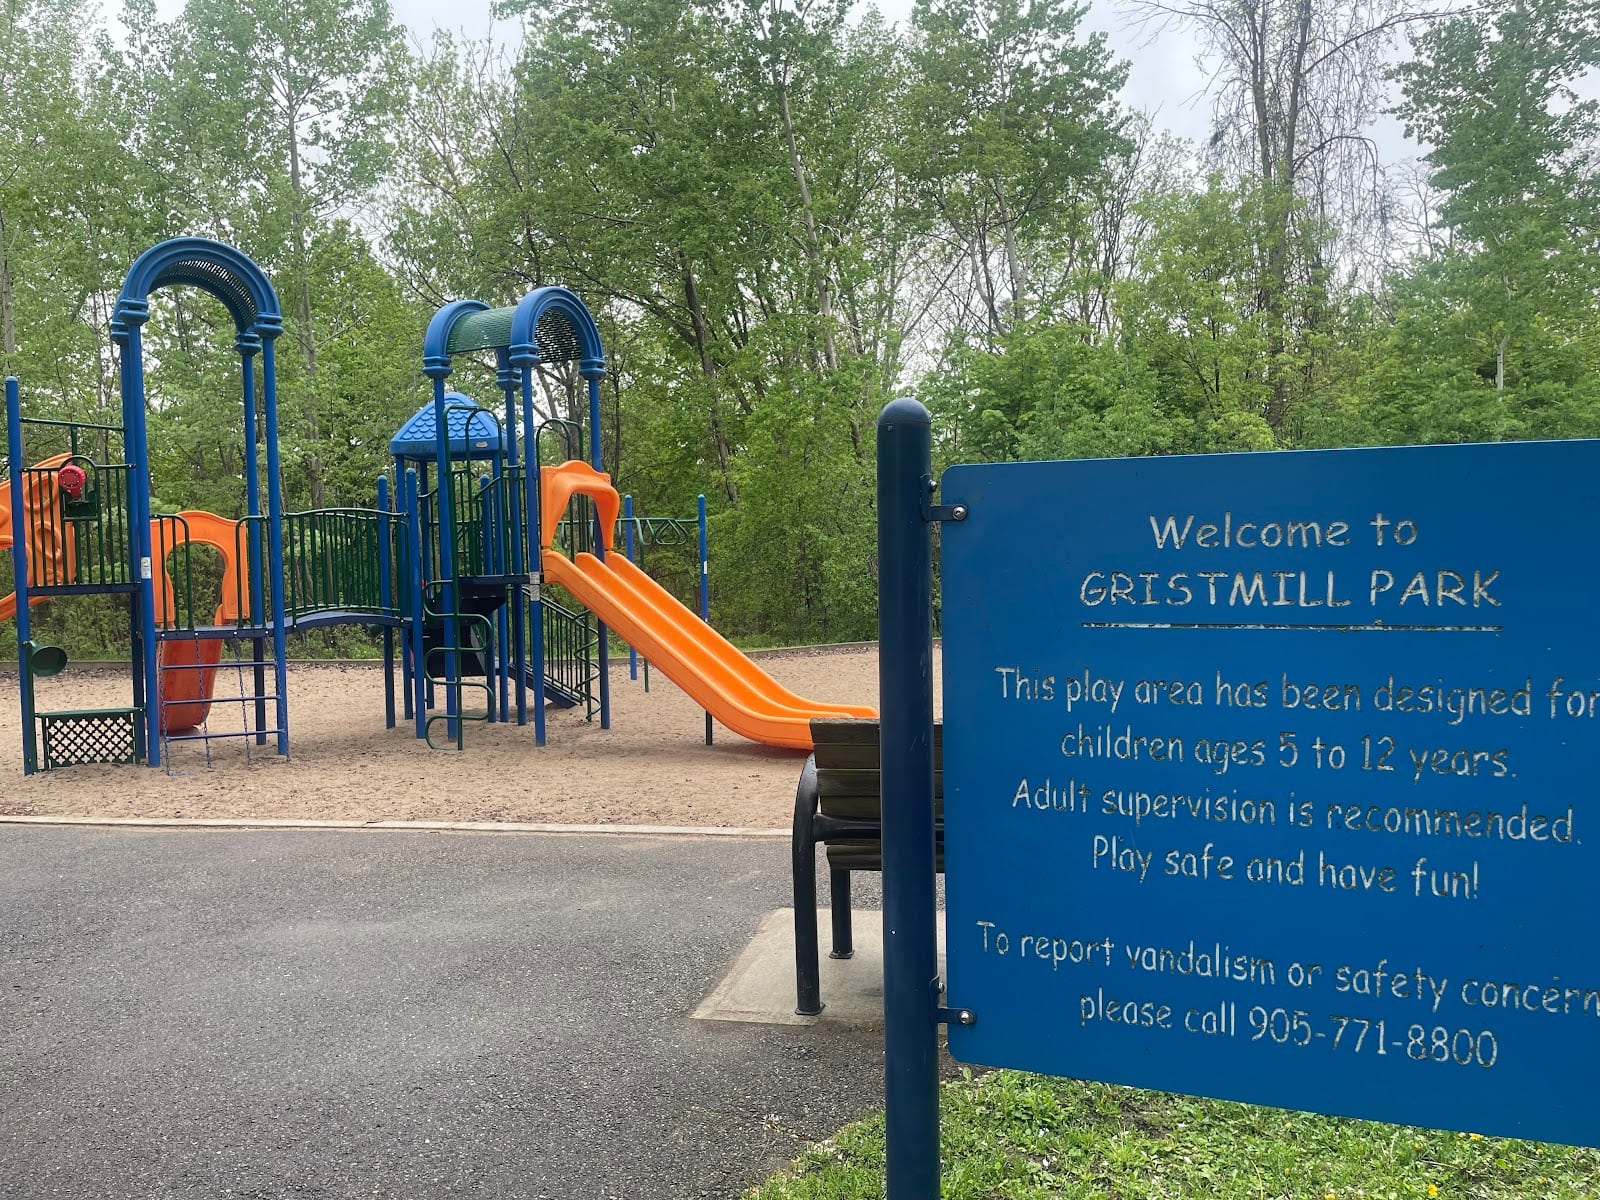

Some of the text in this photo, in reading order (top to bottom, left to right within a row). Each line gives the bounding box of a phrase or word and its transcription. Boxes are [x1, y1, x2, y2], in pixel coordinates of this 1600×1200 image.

[1149, 511, 1418, 550] Welcome to
[1079, 569, 1502, 608] GRISTMILL PARK
[994, 665, 1600, 726] This play area has been designed for
[1061, 722, 1517, 784] children ages 5 to 12 years.
[1011, 777, 1582, 845] Adult supervision is recommended.
[1093, 834, 1479, 900] Play safe and have fun!
[975, 920, 1010, 956] To
[1020, 935, 1115, 972] report
[1125, 942, 1276, 985] vandalism
[1287, 962, 1323, 988] or
[1335, 958, 1448, 1013] safety
[1080, 987, 1498, 1068] please call 905-771-8800
